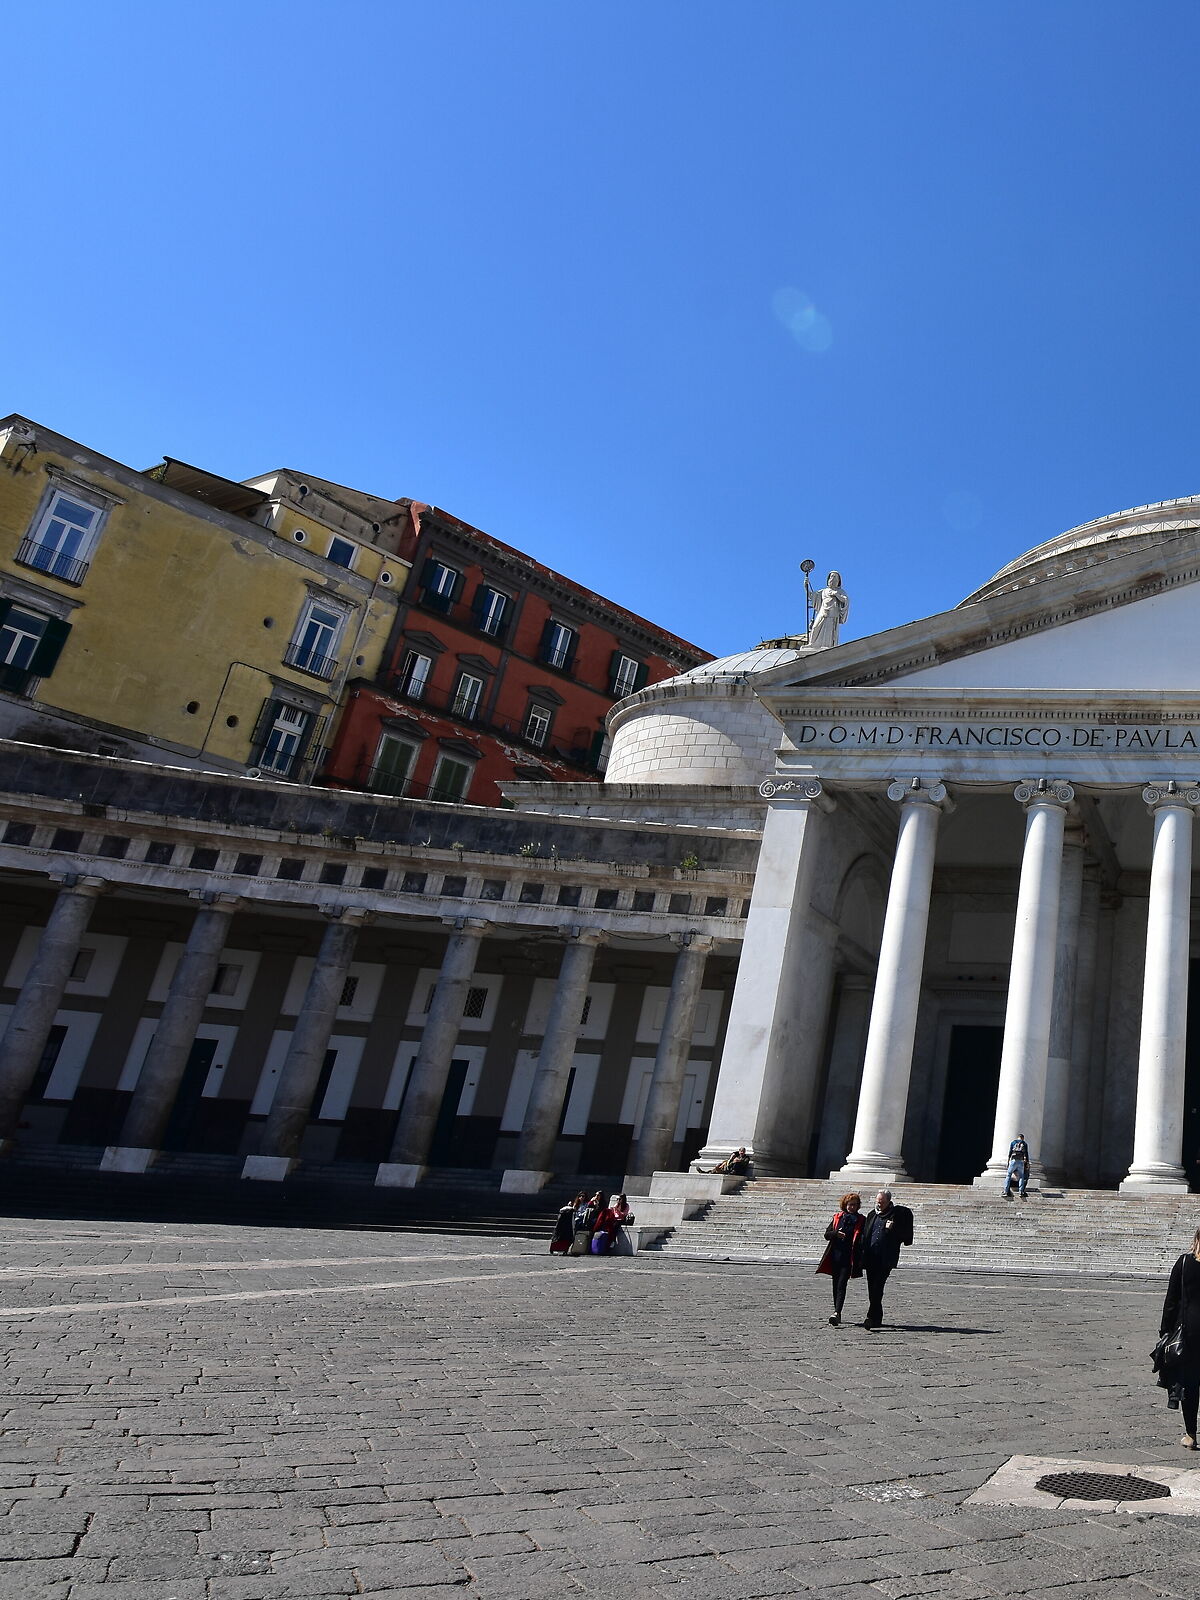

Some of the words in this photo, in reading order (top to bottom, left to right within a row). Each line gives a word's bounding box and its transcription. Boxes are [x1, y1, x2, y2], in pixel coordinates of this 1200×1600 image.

[914, 727, 1061, 746] FRANCISCO
[1072, 728, 1104, 747] DE
[1115, 729, 1197, 748] PAVLA
